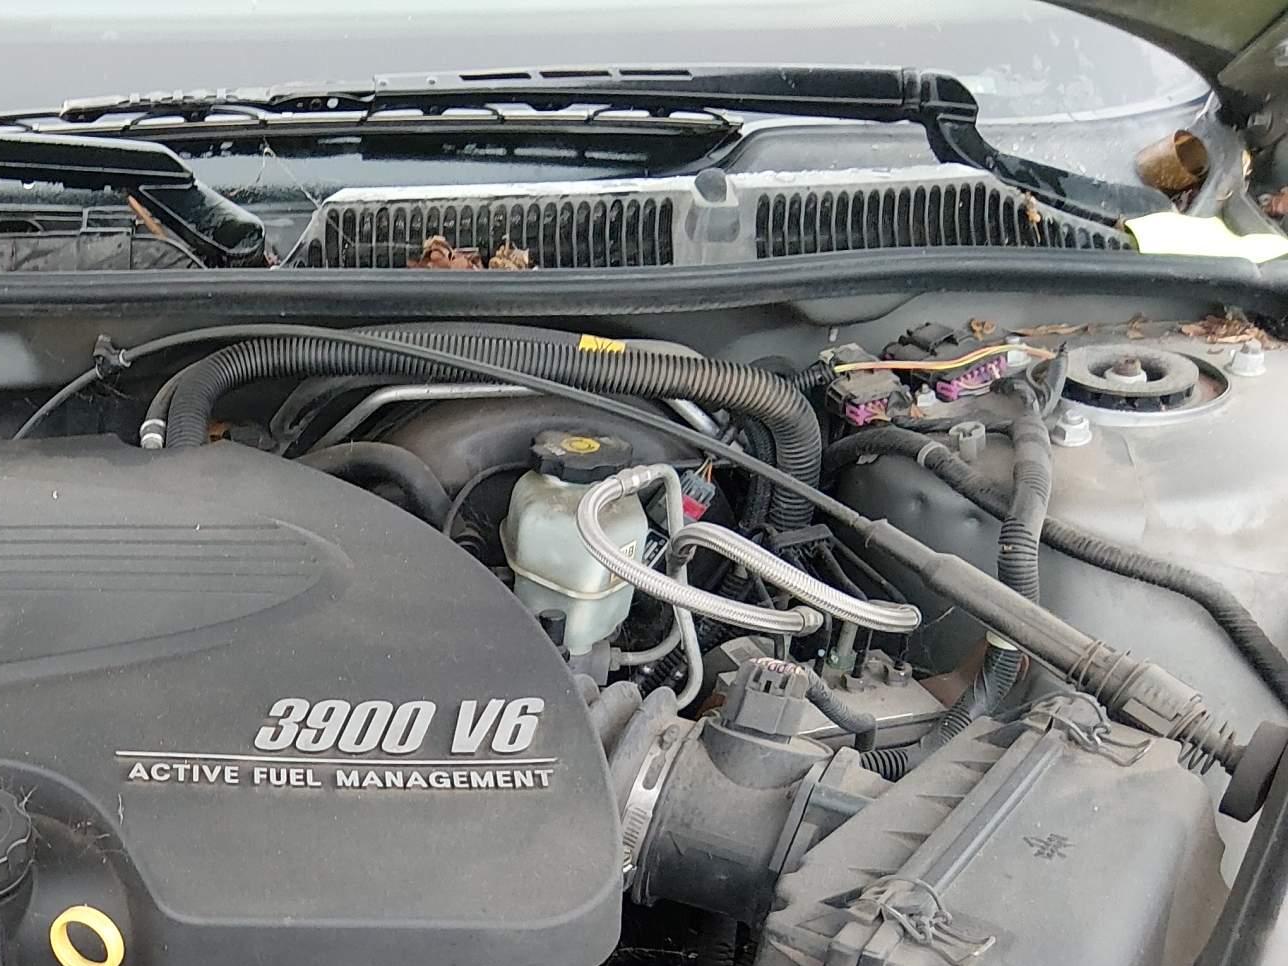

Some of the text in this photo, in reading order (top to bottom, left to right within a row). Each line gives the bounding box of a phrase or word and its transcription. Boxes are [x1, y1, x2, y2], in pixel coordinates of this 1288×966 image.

[254, 697, 544, 754] 3900 V6
[128, 762, 554, 790] ACTIVE FUEL MANAGEMENT
